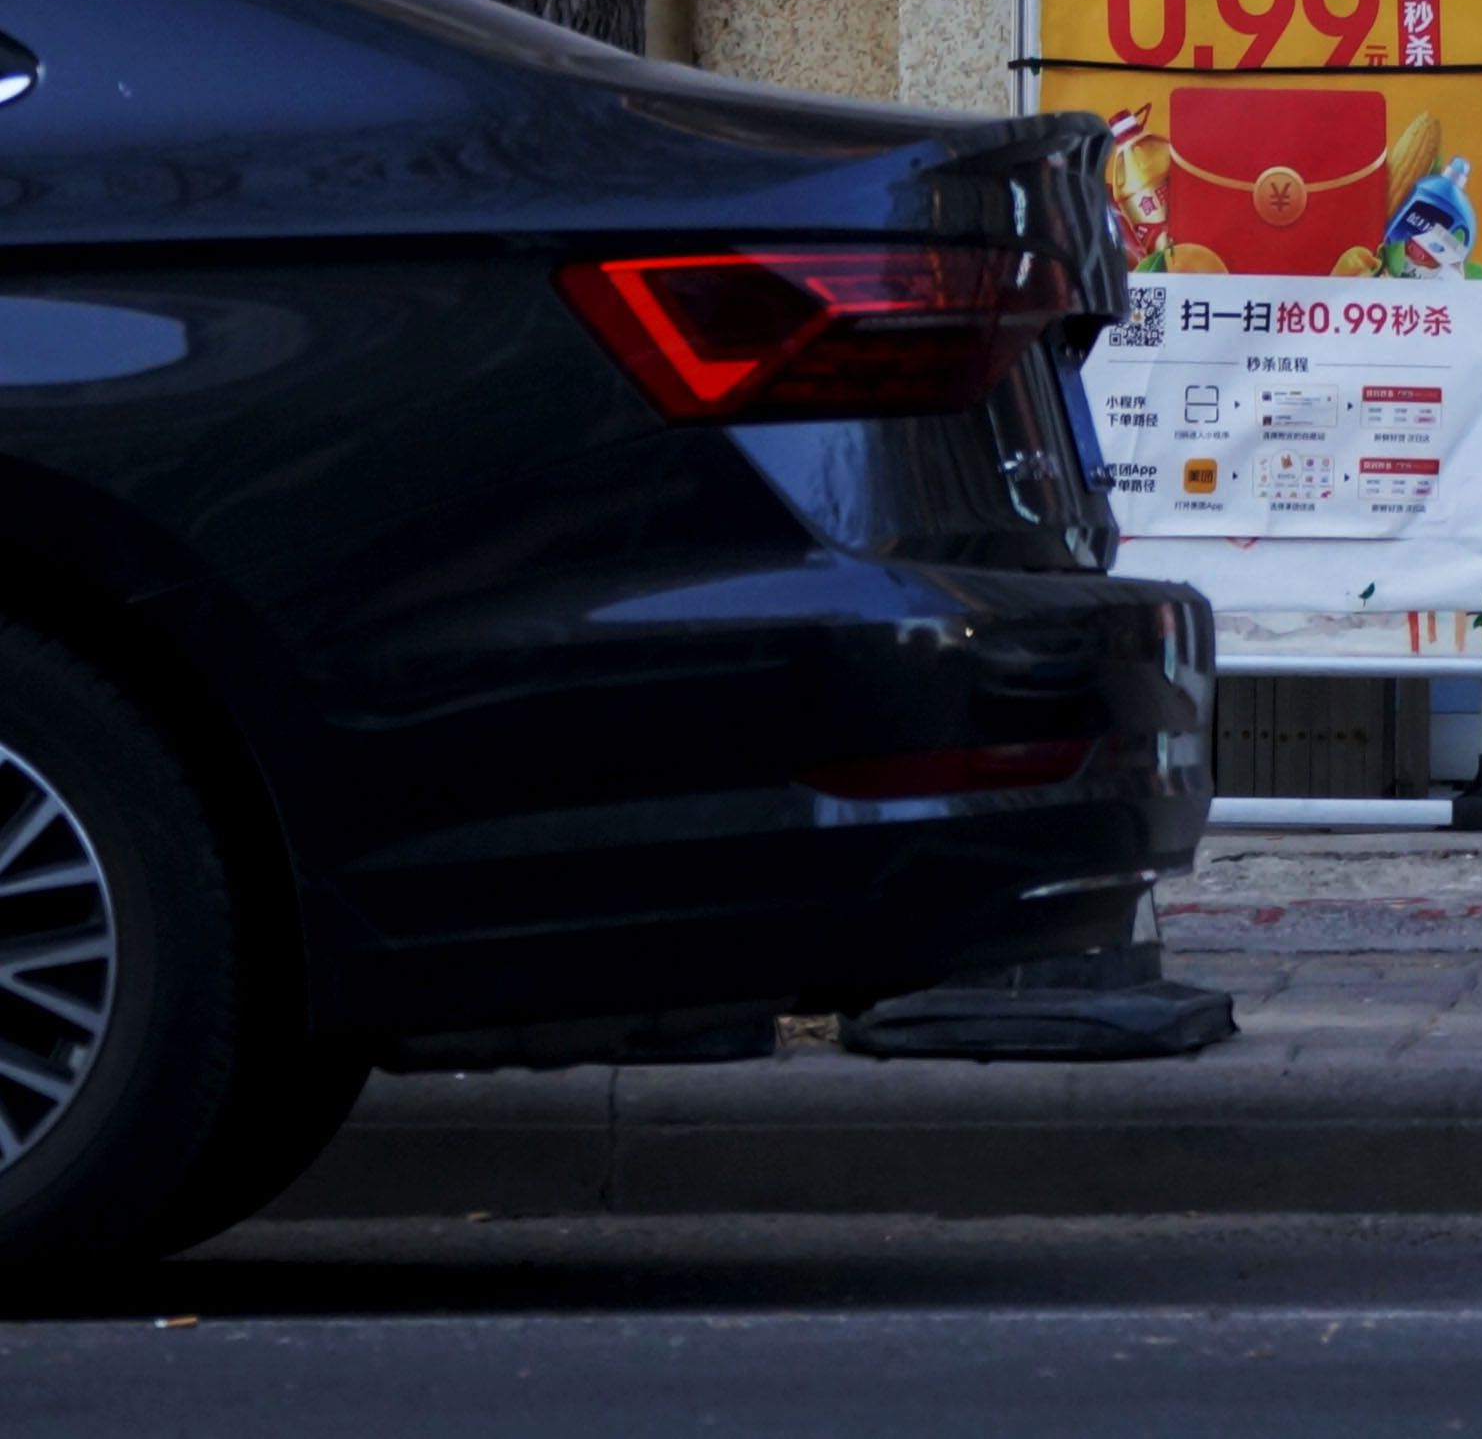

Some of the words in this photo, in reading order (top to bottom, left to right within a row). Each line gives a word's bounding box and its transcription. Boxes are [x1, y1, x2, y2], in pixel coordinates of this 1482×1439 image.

[1181, 298, 1452, 337] 扫一扫抢0.99秒杀
[1245, 356, 1310, 373] 秒杀流程
[1105, 395, 1147, 411] 小程序
[1106, 412, 1158, 428] 下单路径
